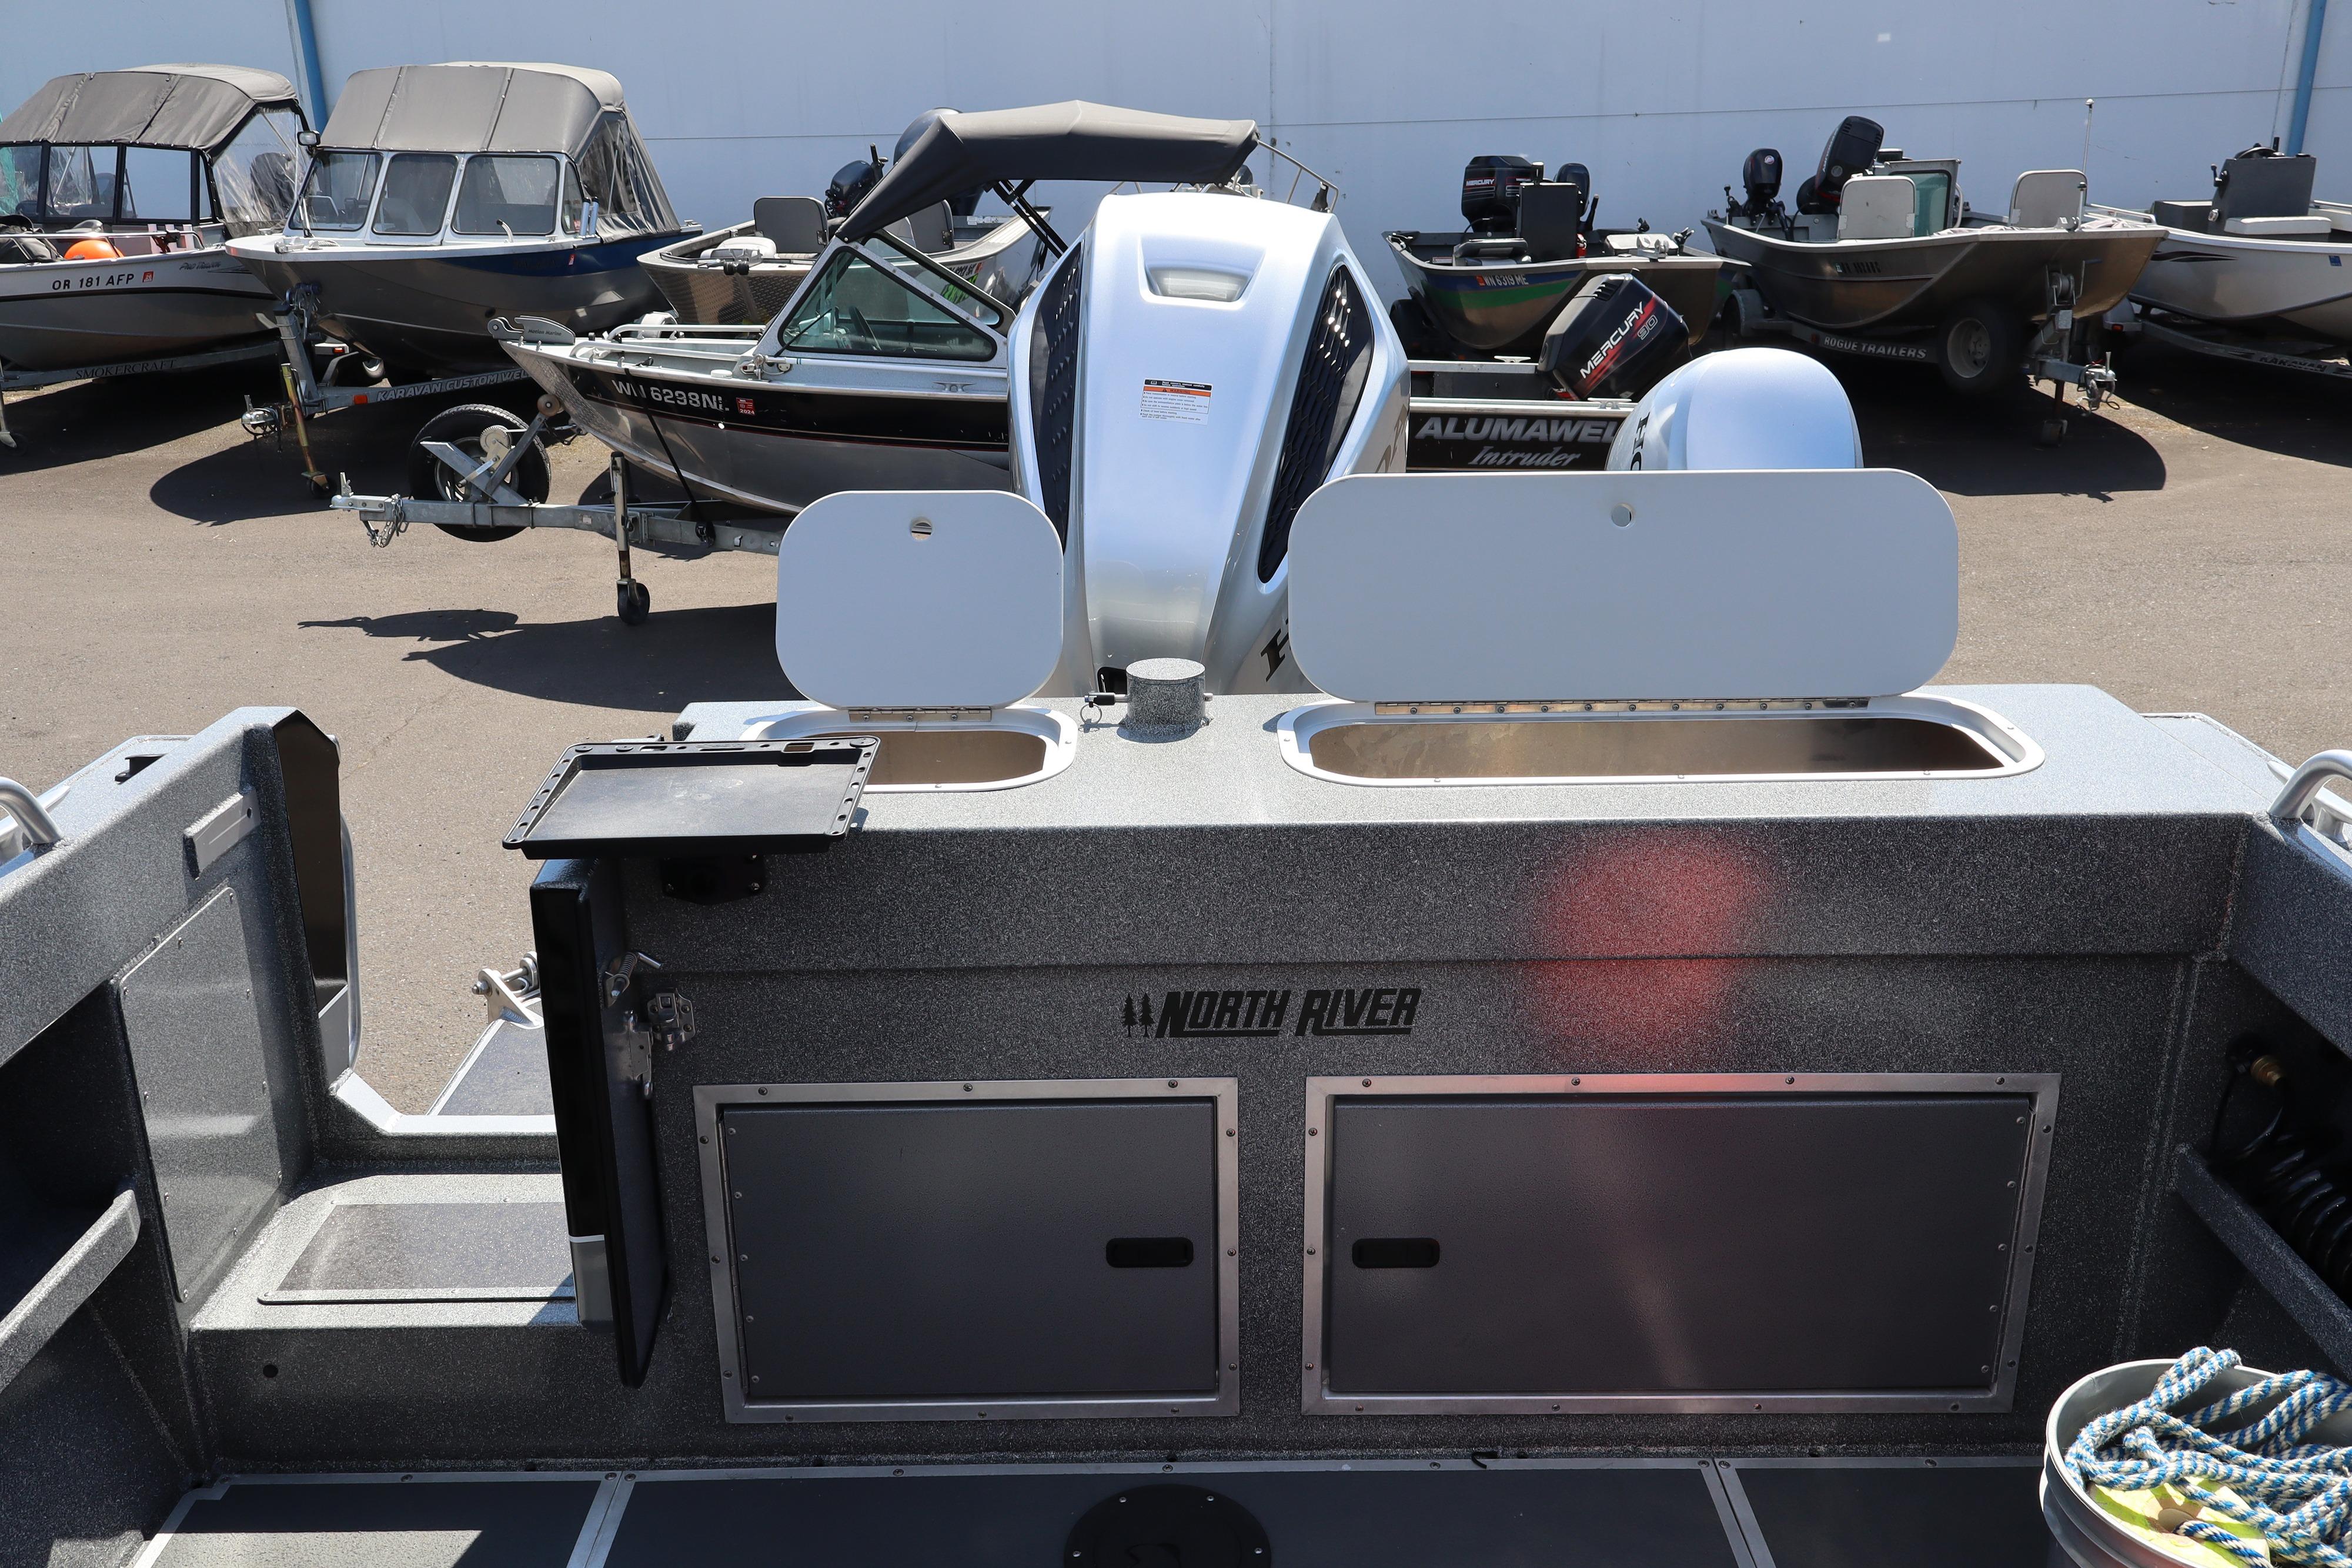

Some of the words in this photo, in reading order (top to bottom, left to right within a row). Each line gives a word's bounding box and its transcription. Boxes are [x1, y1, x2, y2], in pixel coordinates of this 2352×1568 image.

[52, 279, 70, 290] OR
[79, 276, 100, 288] 181
[106, 273, 134, 286] AFP
[1637, 315, 1658, 340] 90
[1580, 301, 1645, 379] MERCURY
[1824, 336, 1858, 351] ROGUE
[1860, 343, 1927, 359] TRAILERS
[75, 360, 176, 379] SMOKERCRAFT
[377, 383, 441, 402] KARAVAN
[445, 373, 499, 390] CUSTOM
[1468, 446, 1581, 467] Intruder
[1155, 989, 1291, 1038] NORTH
[1295, 988, 1422, 1037] RIVER
